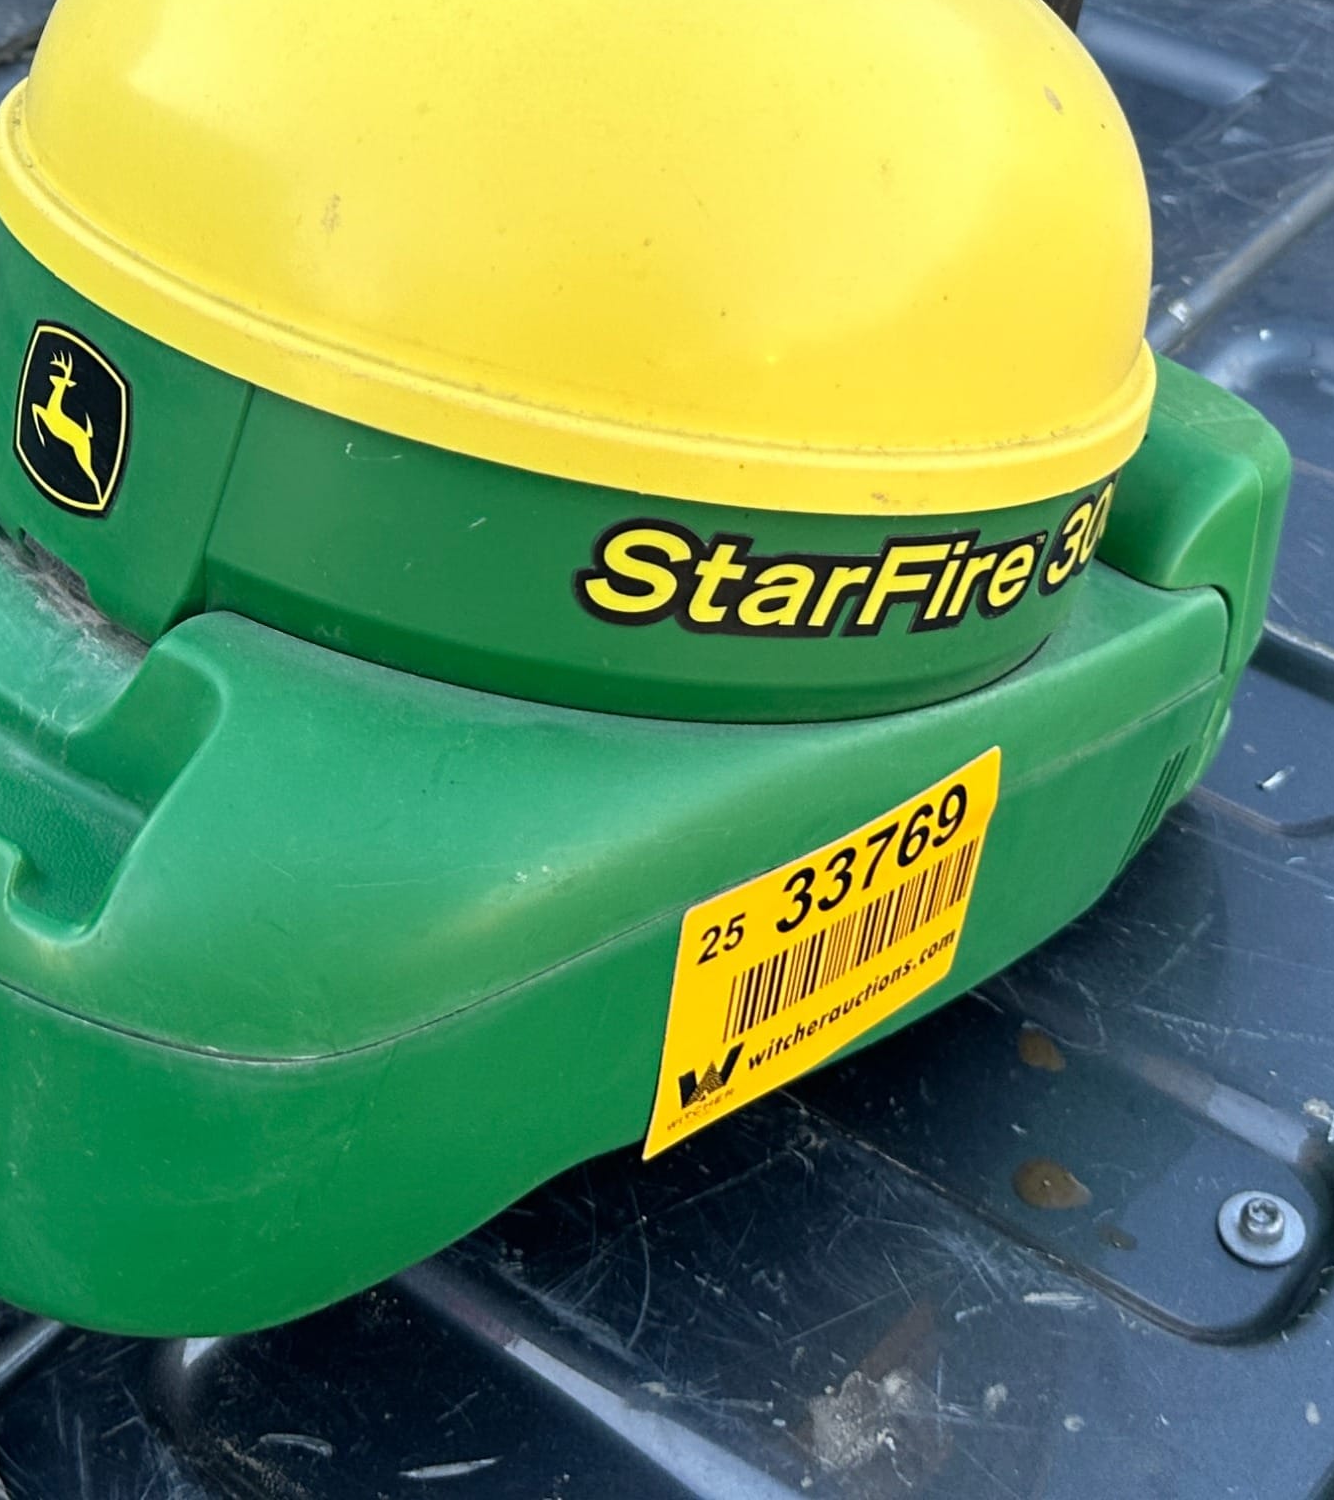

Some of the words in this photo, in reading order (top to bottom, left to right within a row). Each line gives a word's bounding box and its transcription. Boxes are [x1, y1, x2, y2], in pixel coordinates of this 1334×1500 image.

[584, 528, 1035, 628] StarFire
[696, 912, 747, 965] 25
[775, 783, 968, 934] 33769
[747, 929, 957, 1071] witcherauctions.com
